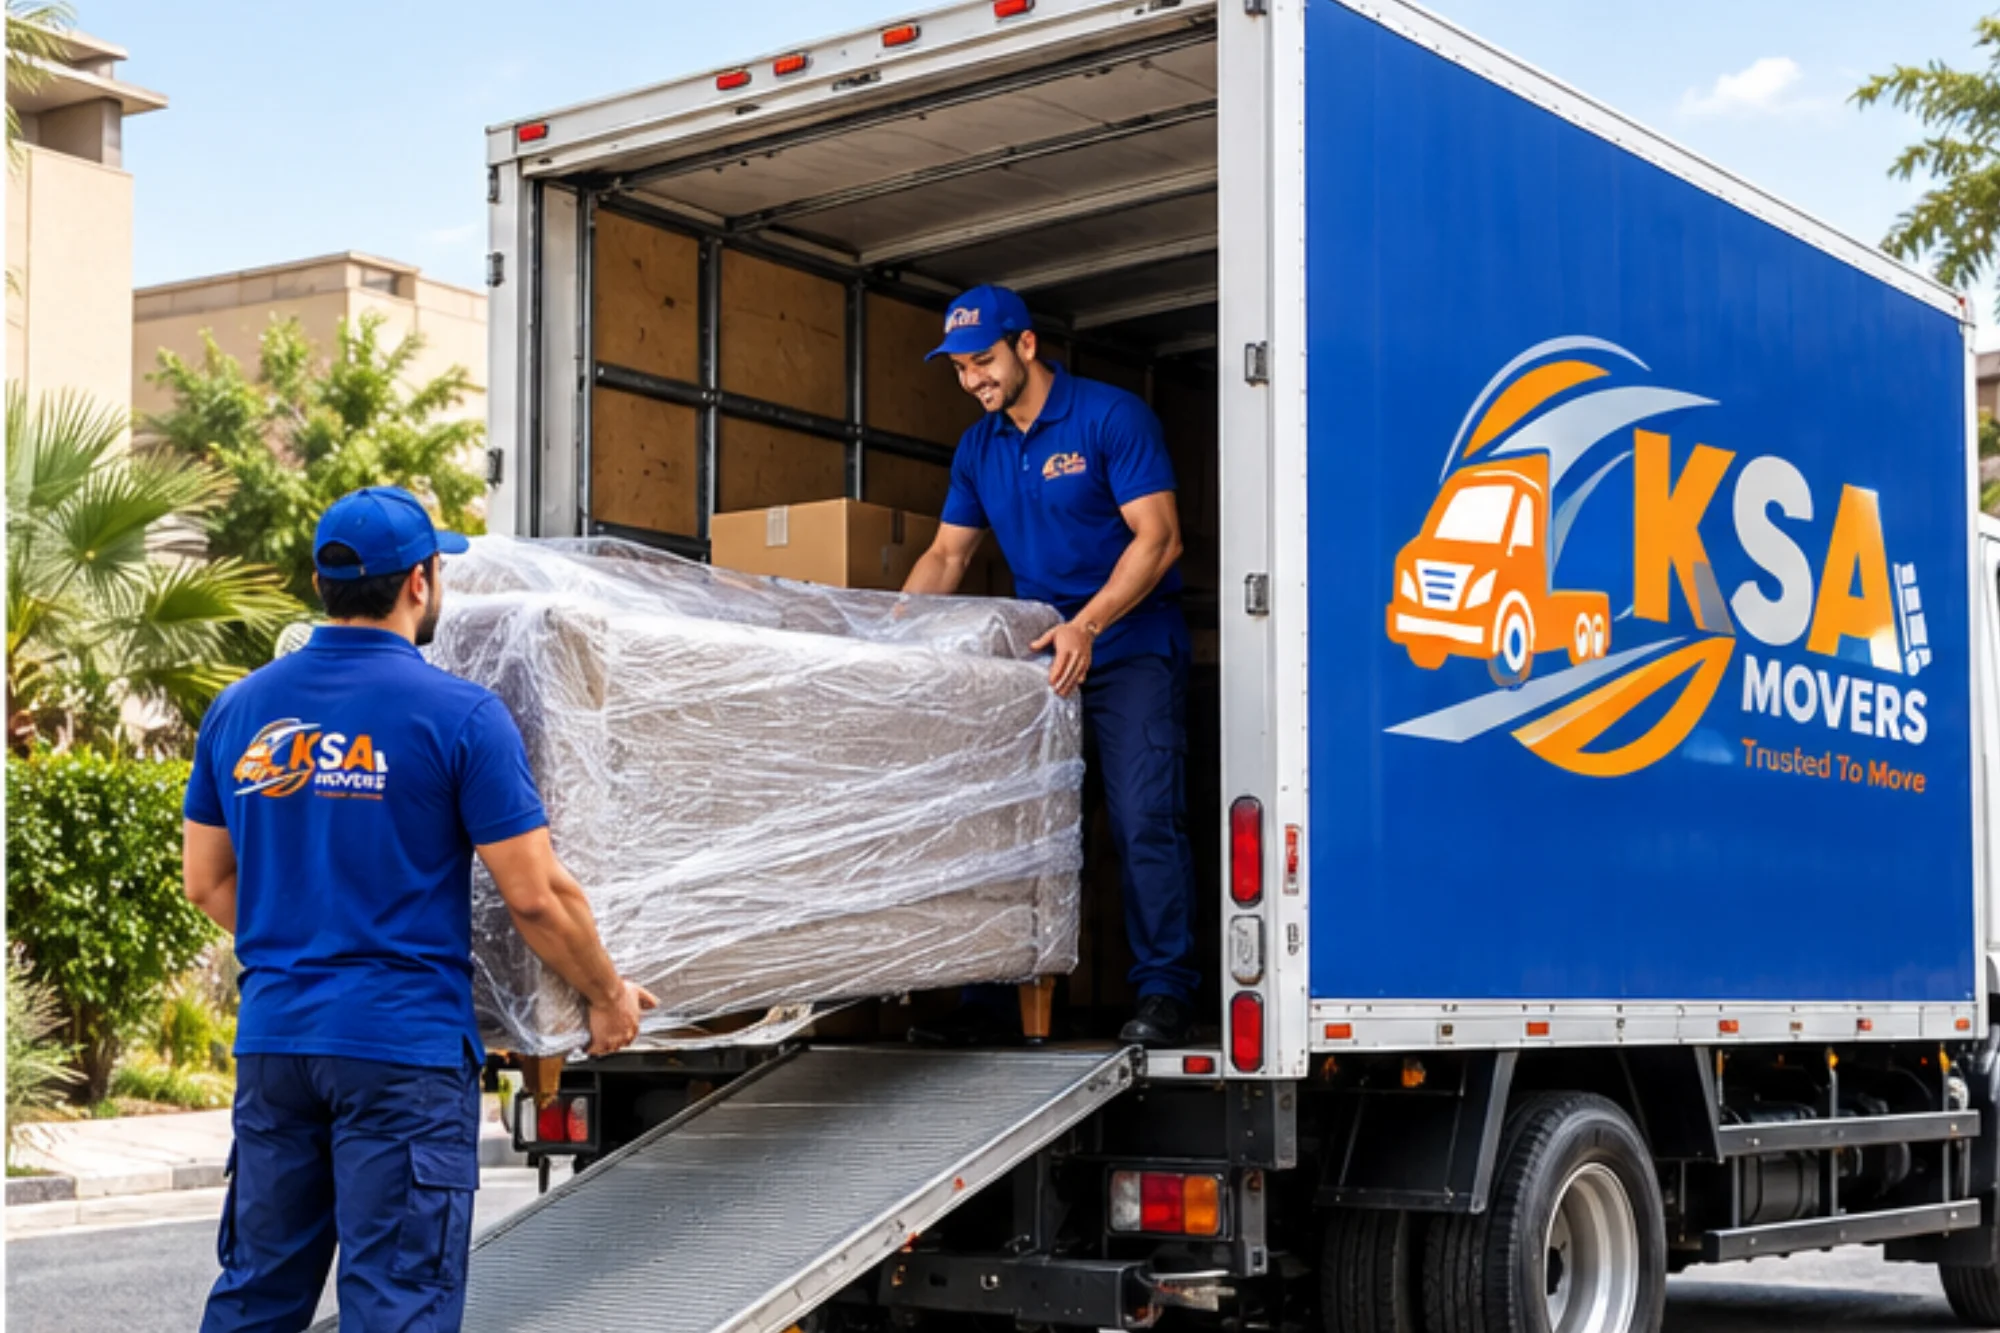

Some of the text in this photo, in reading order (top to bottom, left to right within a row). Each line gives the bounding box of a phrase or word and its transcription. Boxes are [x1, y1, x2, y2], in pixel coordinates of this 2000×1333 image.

[1633, 427, 1903, 674] KSA
[1741, 653, 1929, 746] MOVERS
[288, 731, 376, 772] KSA
[1741, 737, 1926, 793] Trusted To Move
